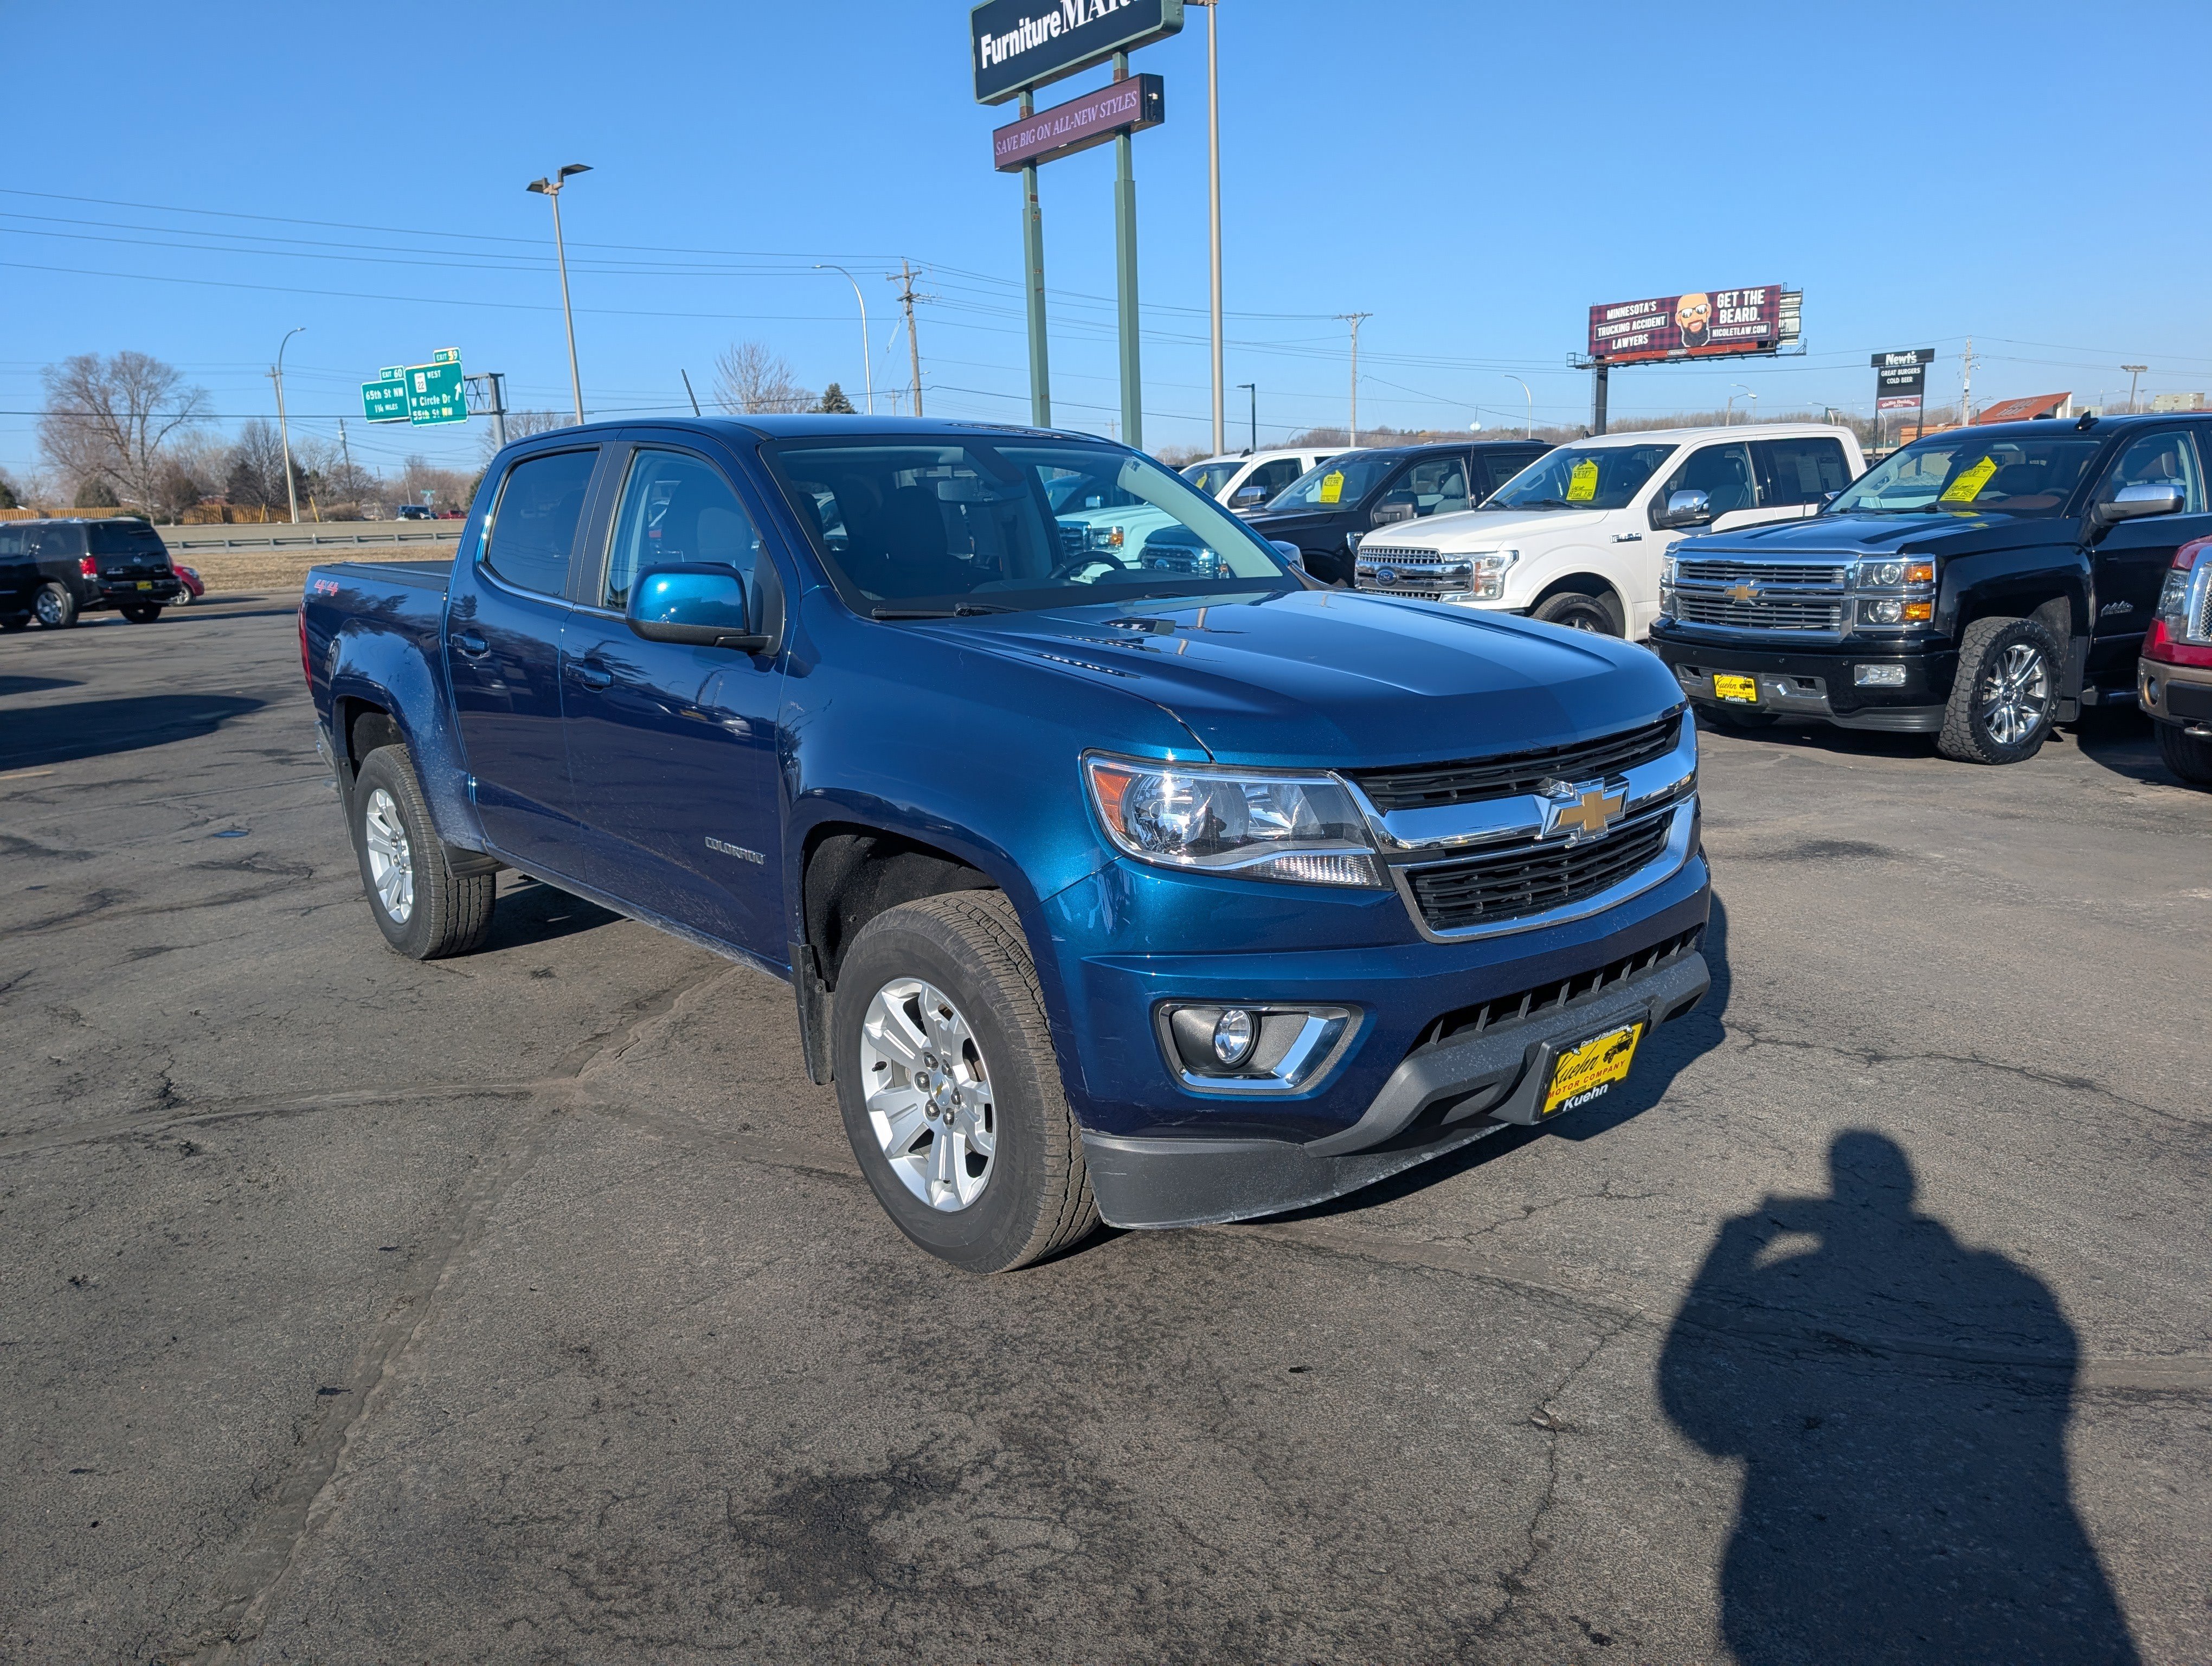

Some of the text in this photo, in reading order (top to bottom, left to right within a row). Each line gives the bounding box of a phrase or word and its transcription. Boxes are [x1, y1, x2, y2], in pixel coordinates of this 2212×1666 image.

[996, 91, 1137, 156] SAVE BIG ON ALL-NEW STYLES
[1717, 289, 1765, 308] GET THE
[1606, 301, 1657, 320] MINNESOTA'S
[1719, 306, 1761, 324] BEARD.
[1598, 316, 1666, 337] TRUCKING ACCIDENT
[1712, 325, 1767, 337] NICOLETLAW.COM
[1612, 334, 1649, 350] LAWYERS
[436, 350, 458, 361] EXIT 59
[1885, 351, 1918, 365] Newt's
[394, 369, 403, 378] 60
[426, 370, 441, 379] WEST
[1881, 367, 1921, 377] GREAT BURGERS
[417, 381, 425, 390] 22
[365, 387, 404, 401] 65th St NW
[411, 393, 451, 407] W Circle Dr
[385, 403, 398, 411] MILES
[413, 407, 453, 421] 55th St NW
[1715, 676, 1737, 689] Kuehn
[1725, 695, 1747, 703] Kuehn
[705, 836, 765, 866] COLORADO
[1580, 1039, 1594, 1048] Cars
[1594, 1034, 1602, 1042] of
[1554, 1043, 1600, 1089] Kuehn
[1547, 1060, 1626, 1099] MOTOR COMPANY
[1562, 1084, 1609, 1112] Kuehn
